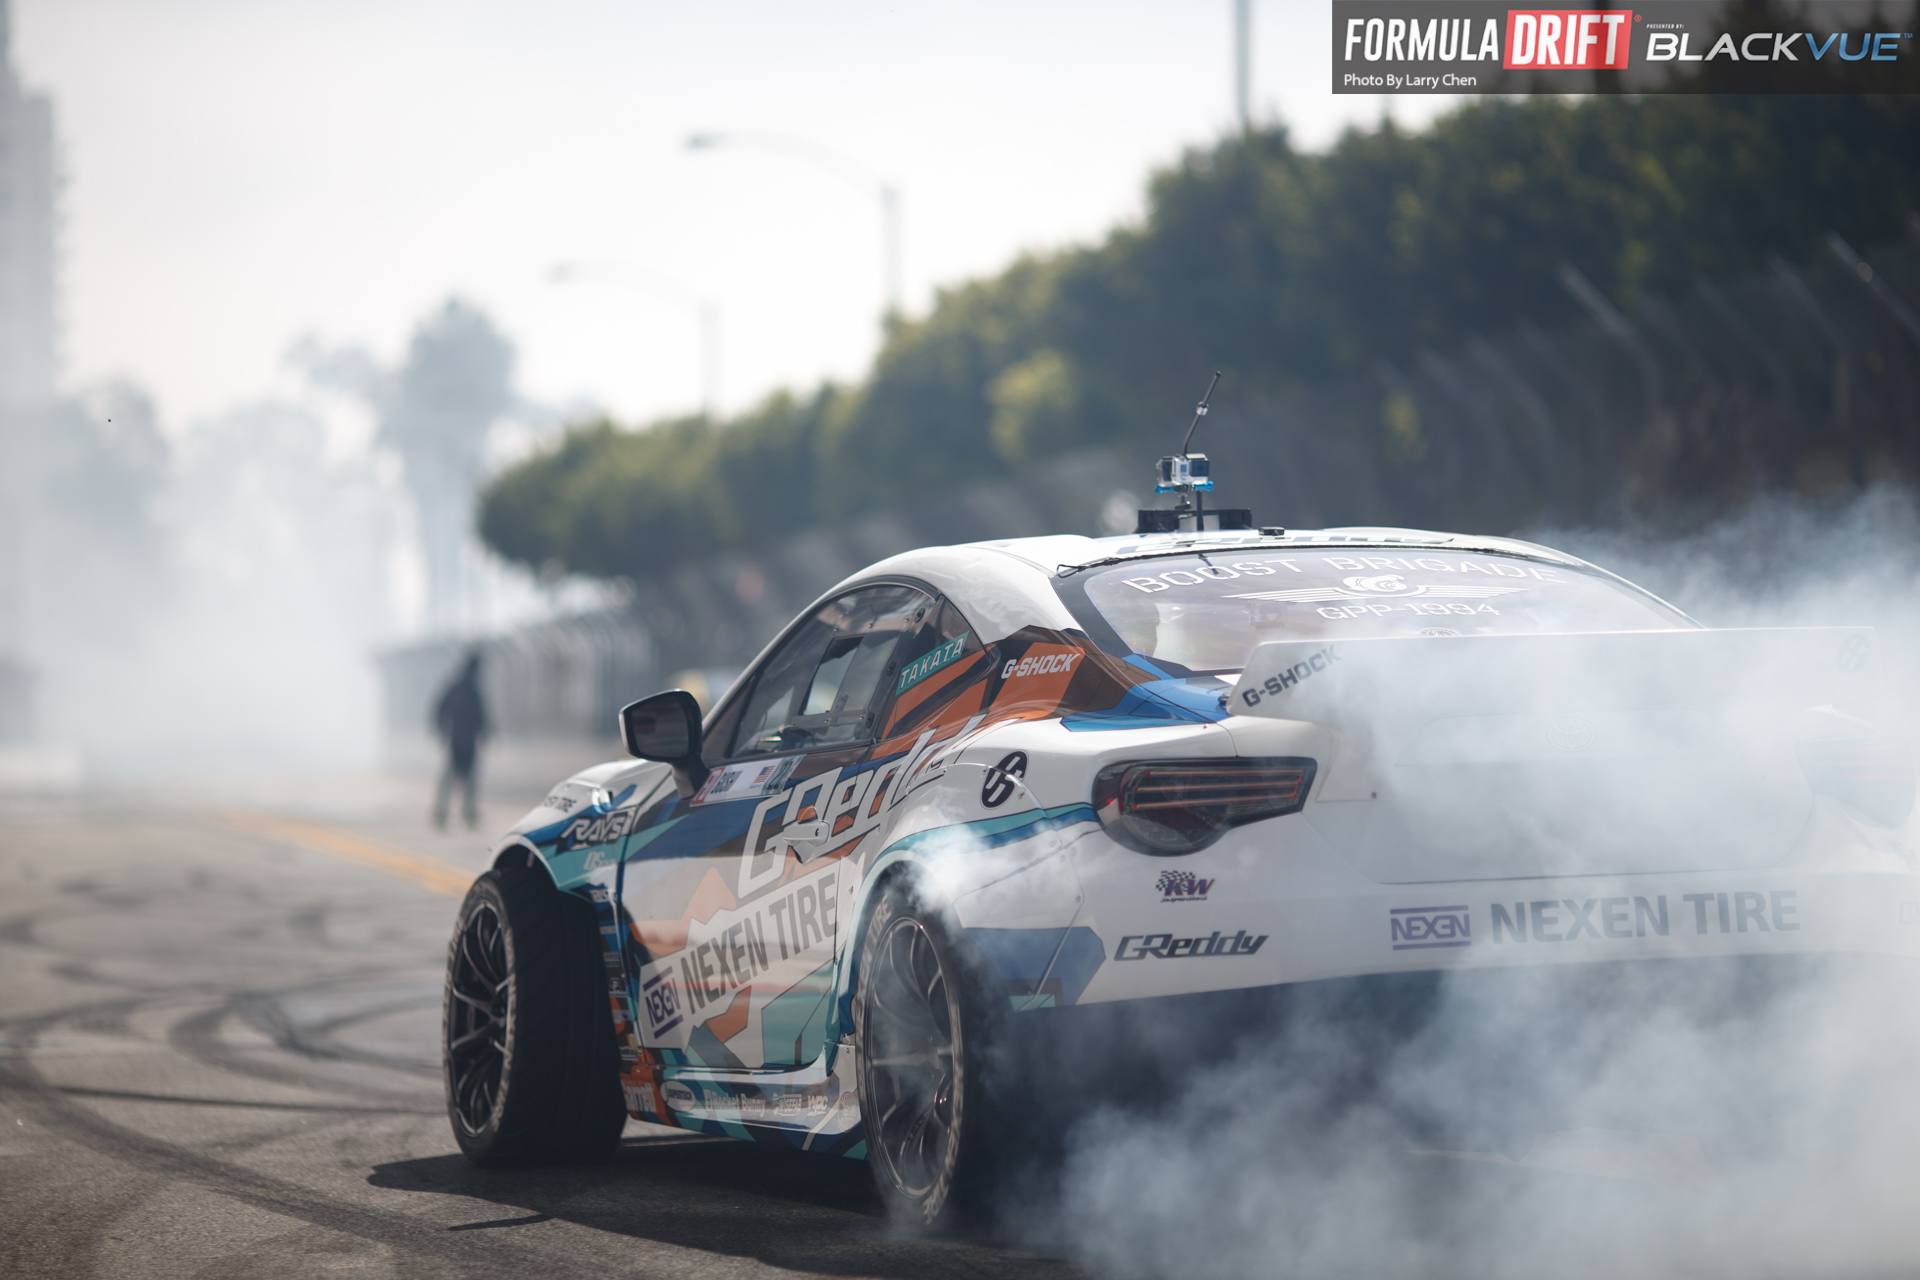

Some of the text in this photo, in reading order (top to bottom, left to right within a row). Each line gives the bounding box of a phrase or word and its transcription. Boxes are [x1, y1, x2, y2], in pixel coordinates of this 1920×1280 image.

[1121, 557, 1567, 593] BOOST BRIGADE
[1316, 603, 1501, 620] GPP-1994
[900, 637, 964, 689] TAKATA
[1001, 653, 1081, 680] G-SHOCK
[1242, 644, 1342, 707] G-SHOCK
[1163, 878, 1216, 897] KW
[1391, 889, 1801, 945] NEXEN NEXEN TIRE
[680, 910, 770, 1016] NEXEN
[769, 871, 840, 967] TIRE
[1113, 930, 1269, 963] GReddy
